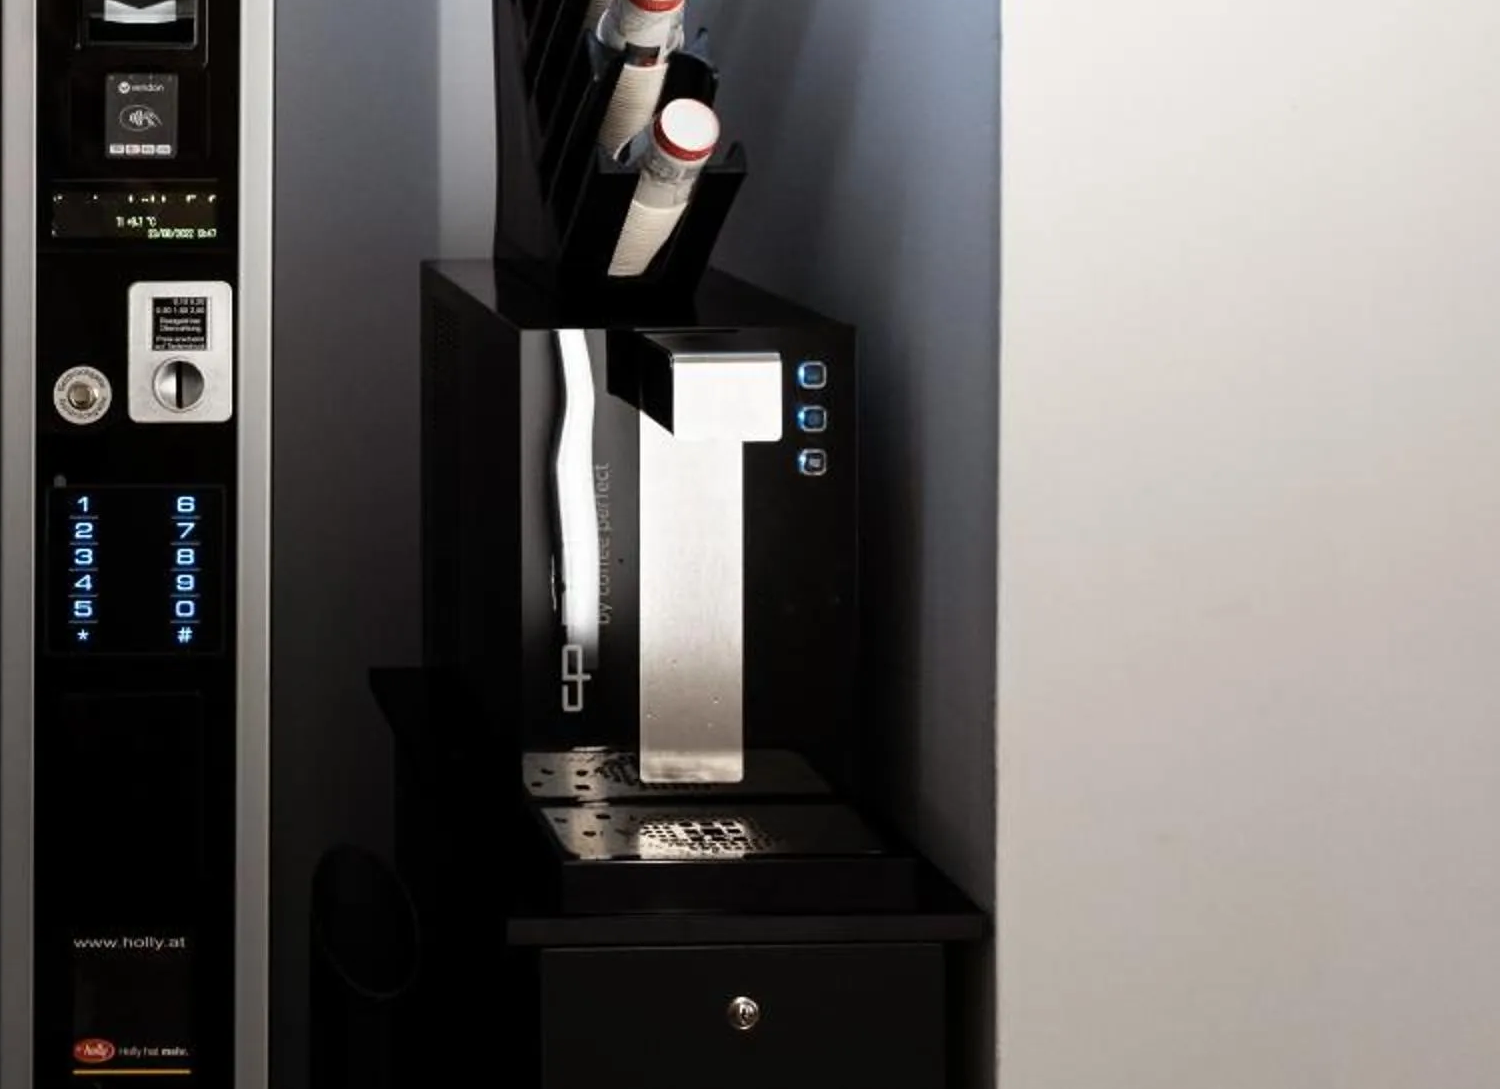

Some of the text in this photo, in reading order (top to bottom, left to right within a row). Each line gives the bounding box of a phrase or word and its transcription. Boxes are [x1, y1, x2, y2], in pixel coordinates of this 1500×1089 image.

[77, 496, 89, 512] 1
[176, 496, 195, 513] 6
[74, 522, 93, 539] 2
[175, 522, 195, 539] 7
[74, 548, 93, 565] 3
[175, 548, 195, 565] 8
[74, 574, 92, 591] 4
[175, 574, 195, 591] 9
[73, 600, 93, 617] 5
[175, 600, 195, 617] 0
[73, 937, 185, 950] www.holly.at
